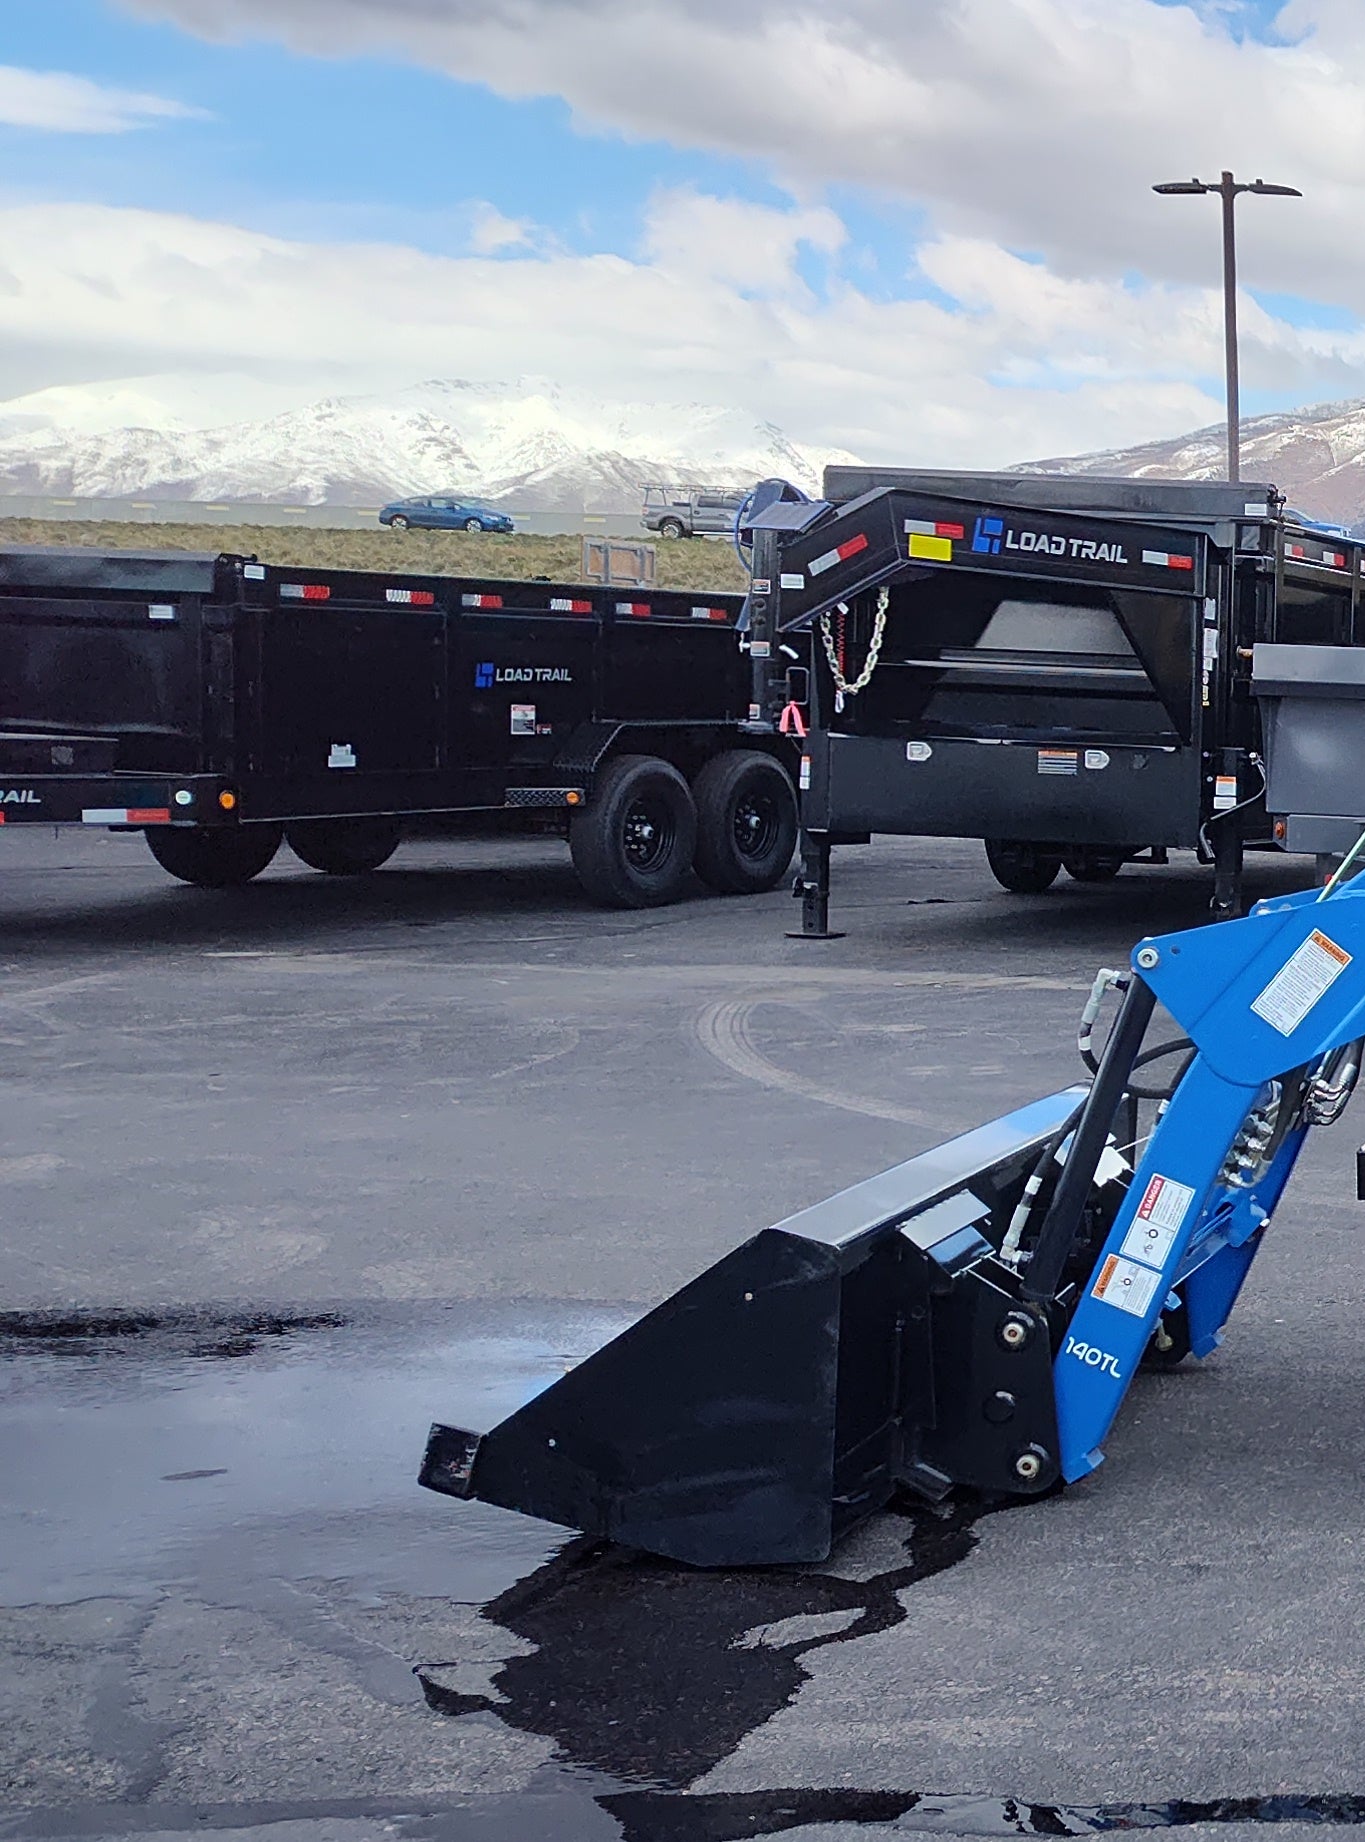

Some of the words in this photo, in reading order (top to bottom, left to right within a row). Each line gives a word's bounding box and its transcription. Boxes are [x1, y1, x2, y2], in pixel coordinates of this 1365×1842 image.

[1004, 530, 1066, 556] LOAD
[1067, 538, 1128, 564] TRAIL
[496, 668, 534, 682] LOAD
[535, 668, 573, 682] TRAIL
[1144, 1178, 1164, 1210] DANGER
[1065, 1336, 1121, 1379] 140TL
